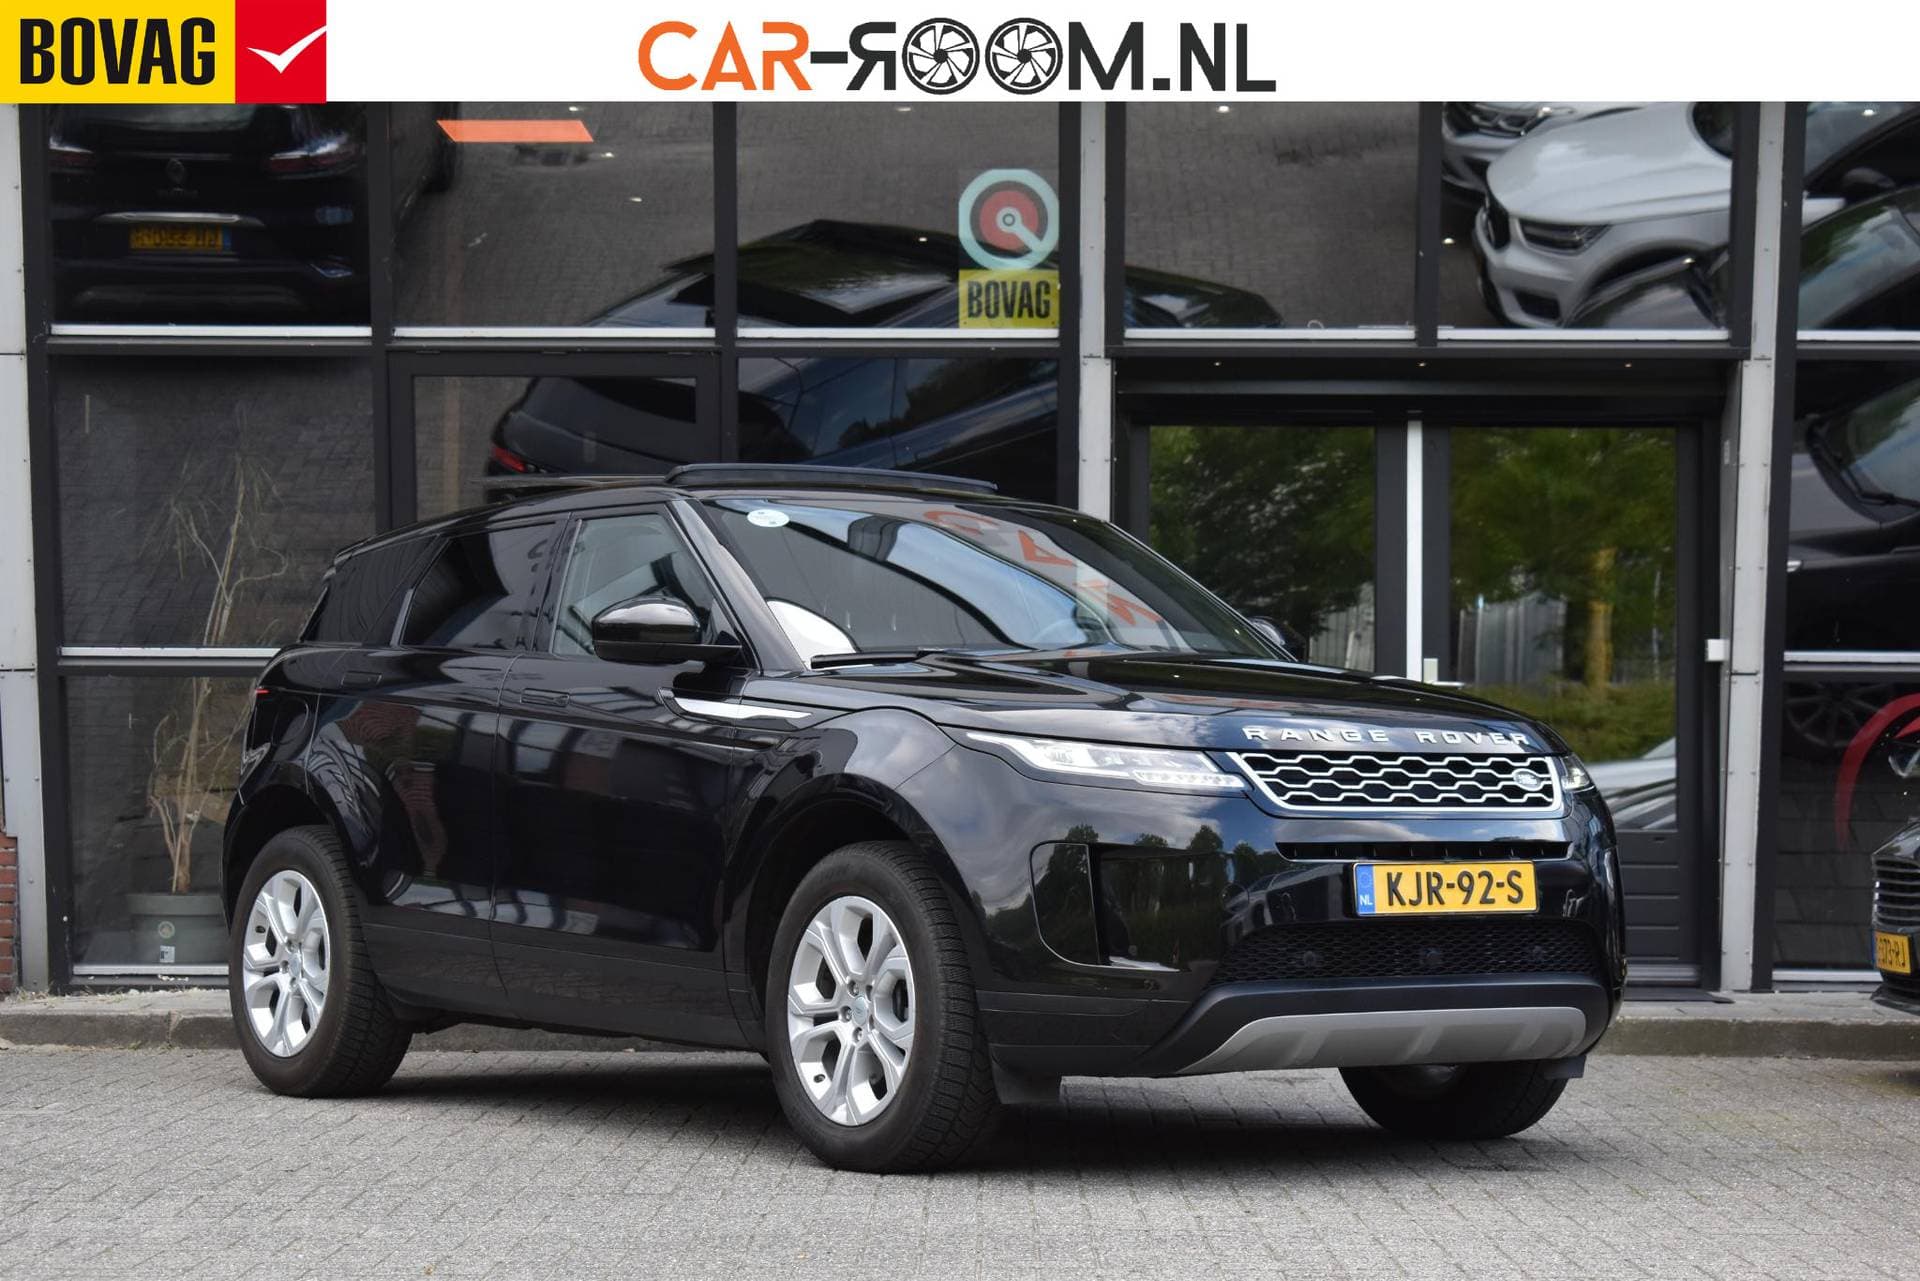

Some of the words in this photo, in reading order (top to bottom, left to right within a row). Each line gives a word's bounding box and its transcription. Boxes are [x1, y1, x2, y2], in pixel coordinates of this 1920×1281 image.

[967, 279, 1050, 319] BOVAG
[1242, 727, 1389, 743] RANGE
[1415, 730, 1530, 745] ROVER
[1359, 895, 1373, 906] NL
[1386, 870, 1524, 907] KJR-92-S
